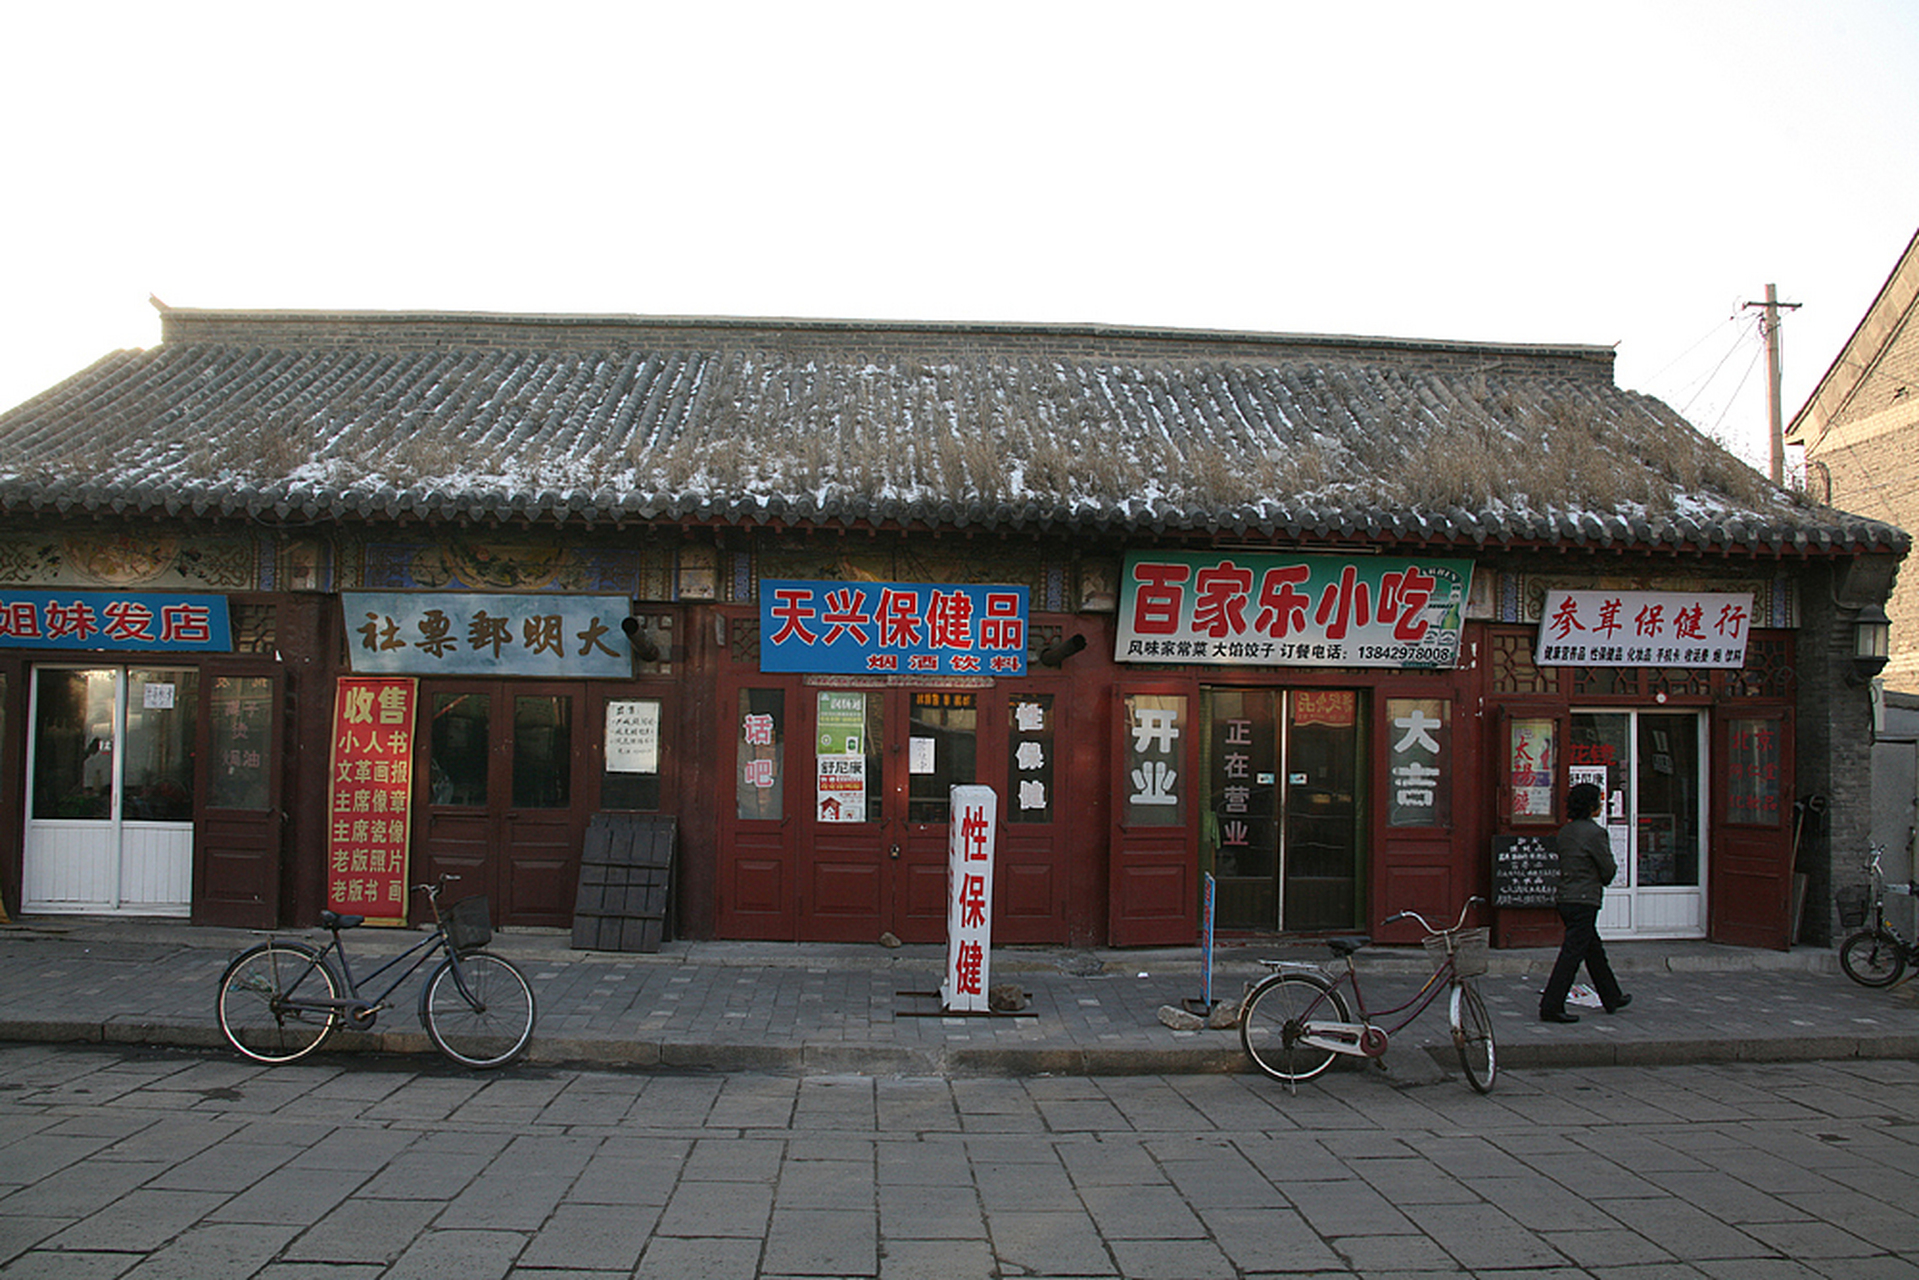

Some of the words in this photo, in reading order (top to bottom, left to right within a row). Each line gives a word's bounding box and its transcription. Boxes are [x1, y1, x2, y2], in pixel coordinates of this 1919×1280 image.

[770, 588, 1024, 651] 天兴保健品
[1133, 560, 1436, 642] 百家乐小吃
[1549, 595, 1747, 640] 参茸保健行
[0, 600, 210, 642] 姐妹发店
[867, 654, 1022, 672] 烟酒饮料
[1127, 640, 1209, 658] 风味家常菜
[1212, 642, 1276, 659] 大馅饺子
[1358, 645, 1451, 662] 13842978008
[343, 686, 408, 724] 收售
[338, 730, 409, 755] 小人书
[743, 714, 775, 788] 话吧
[1130, 709, 1180, 805] 开业
[1392, 710, 1441, 806] 大吉
[1731, 728, 1775, 751] 北京
[336, 759, 408, 784] 文革画报
[820, 761, 863, 774] 舒尼康
[1223, 719, 1252, 847] 正在营业
[334, 789, 407, 814] 主席像章
[333, 819, 405, 844] 主席瓷像
[332, 848, 403, 873] 老版照片
[956, 805, 989, 995] 性保健
